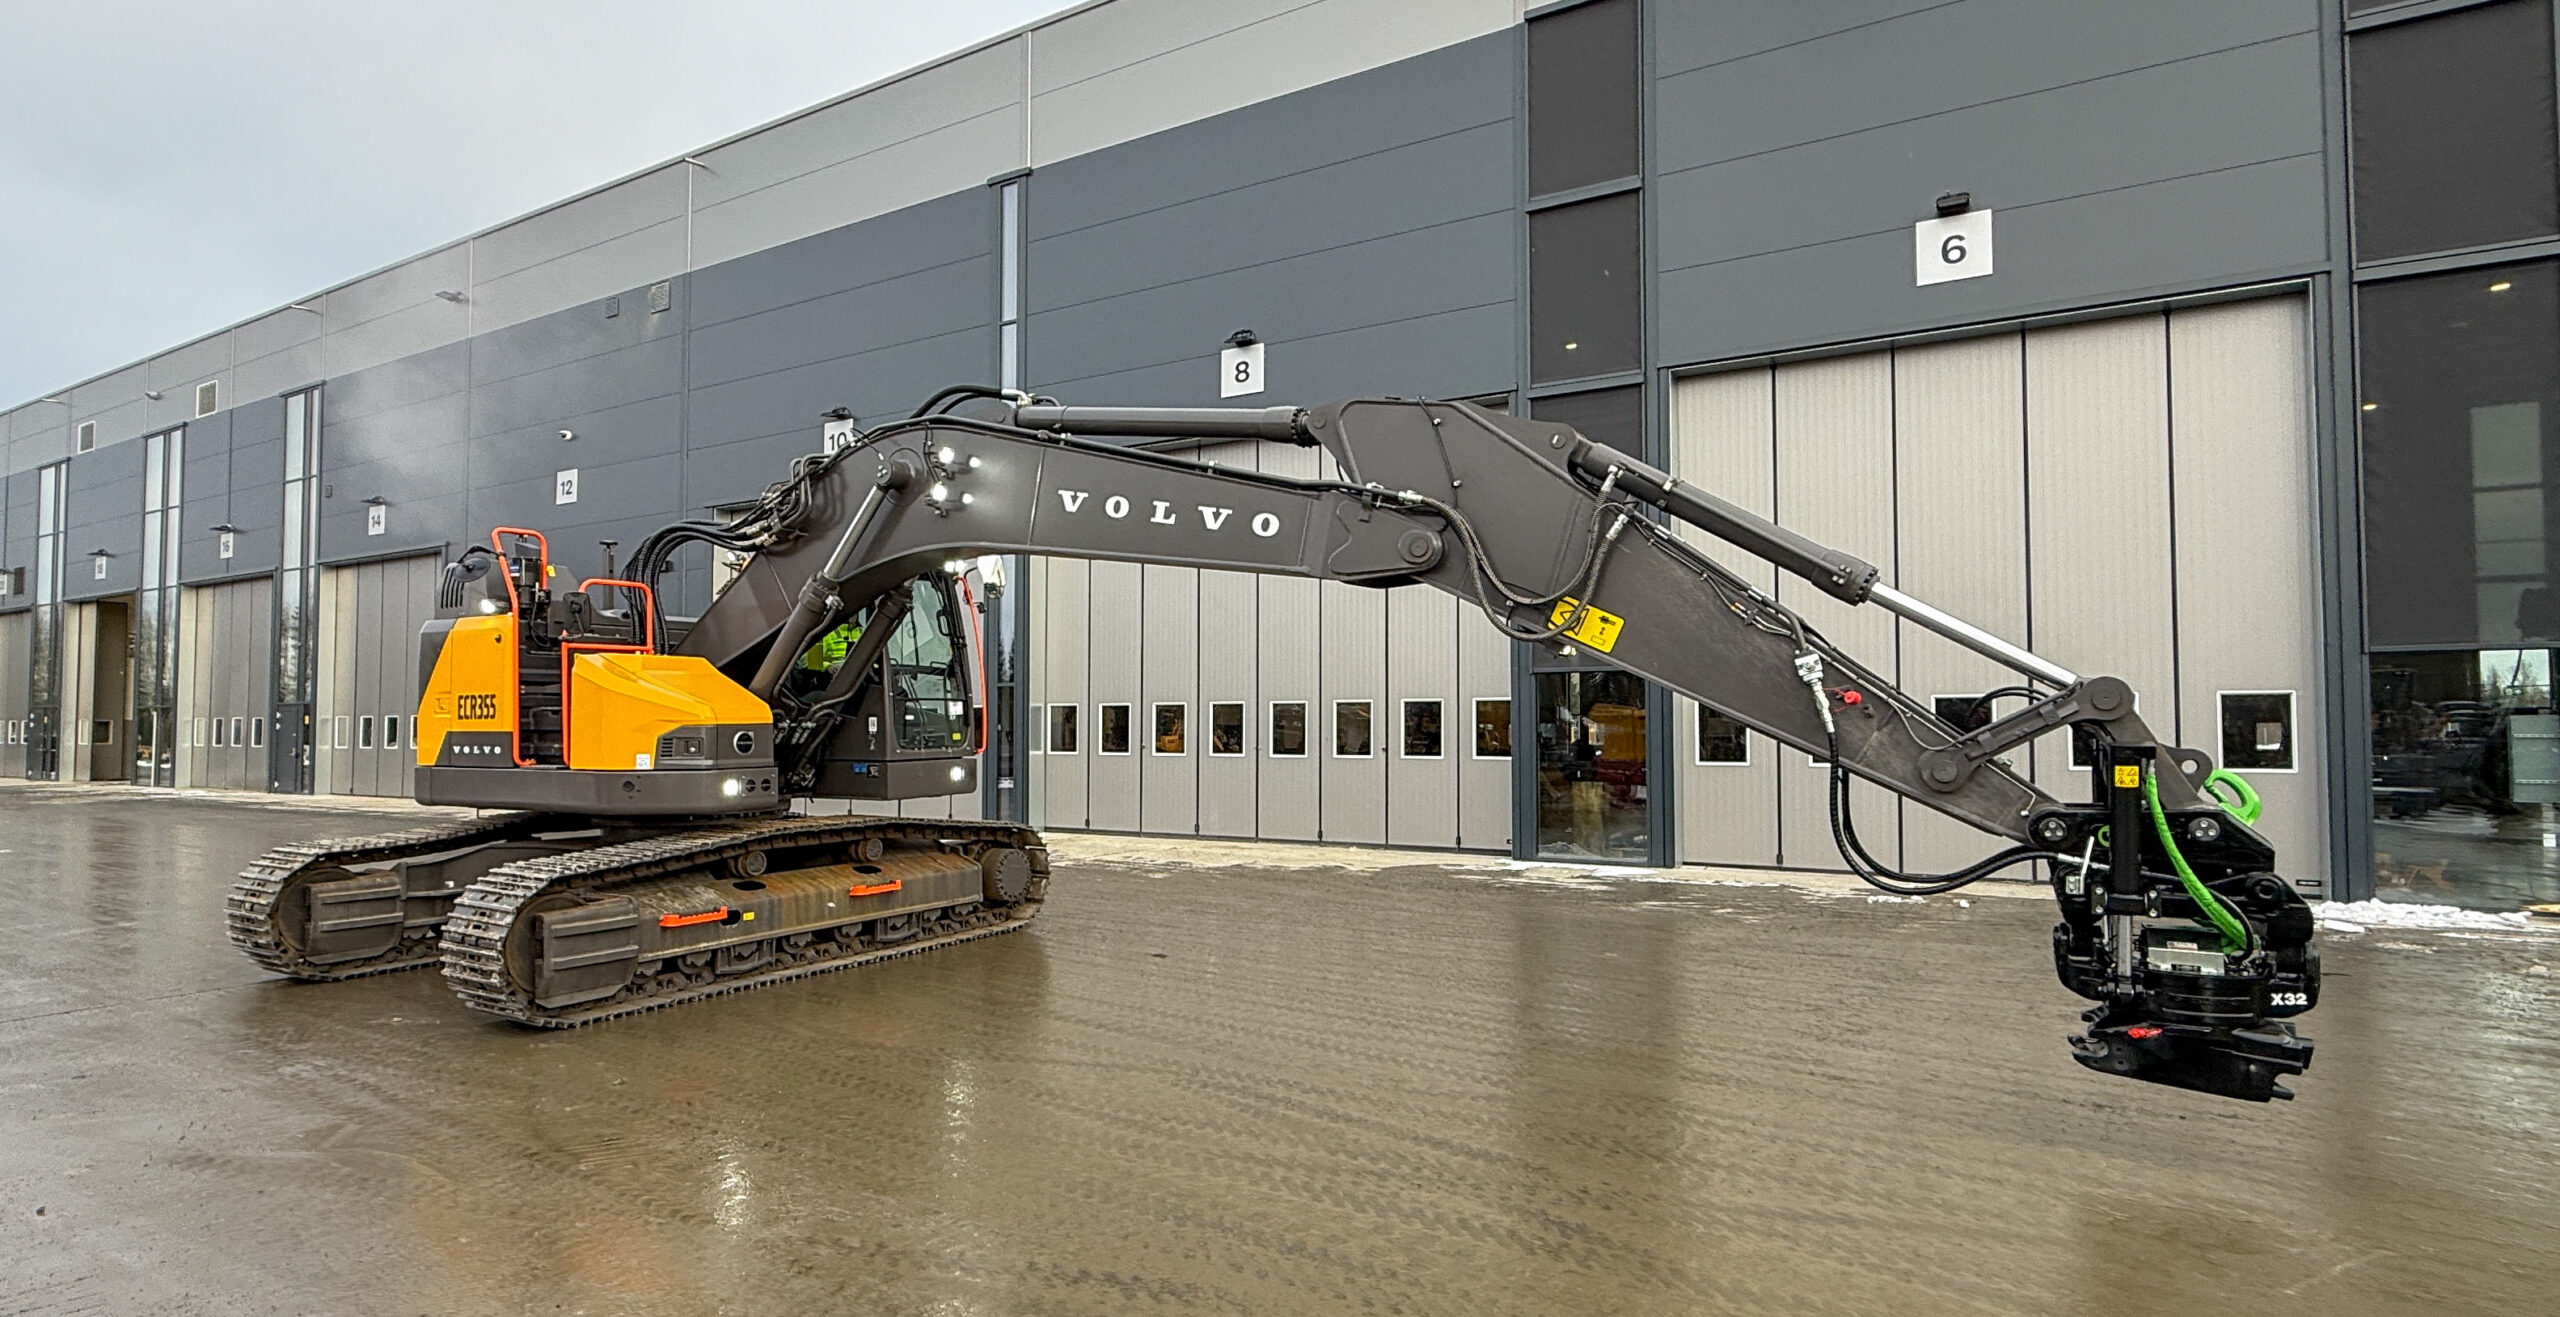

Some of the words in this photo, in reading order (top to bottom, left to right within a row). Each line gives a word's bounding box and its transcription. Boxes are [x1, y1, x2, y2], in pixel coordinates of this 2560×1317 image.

[1941, 234, 1967, 265] 6
[1235, 360, 1250, 383] 8
[829, 431, 848, 451] 10
[560, 479, 573, 496] 12
[371, 514, 381, 528] 14
[1057, 489, 1280, 538] VOLVO
[457, 694, 497, 720] ECR355
[452, 745, 502, 755] VOLVO
[2270, 992, 2309, 1006] X32
